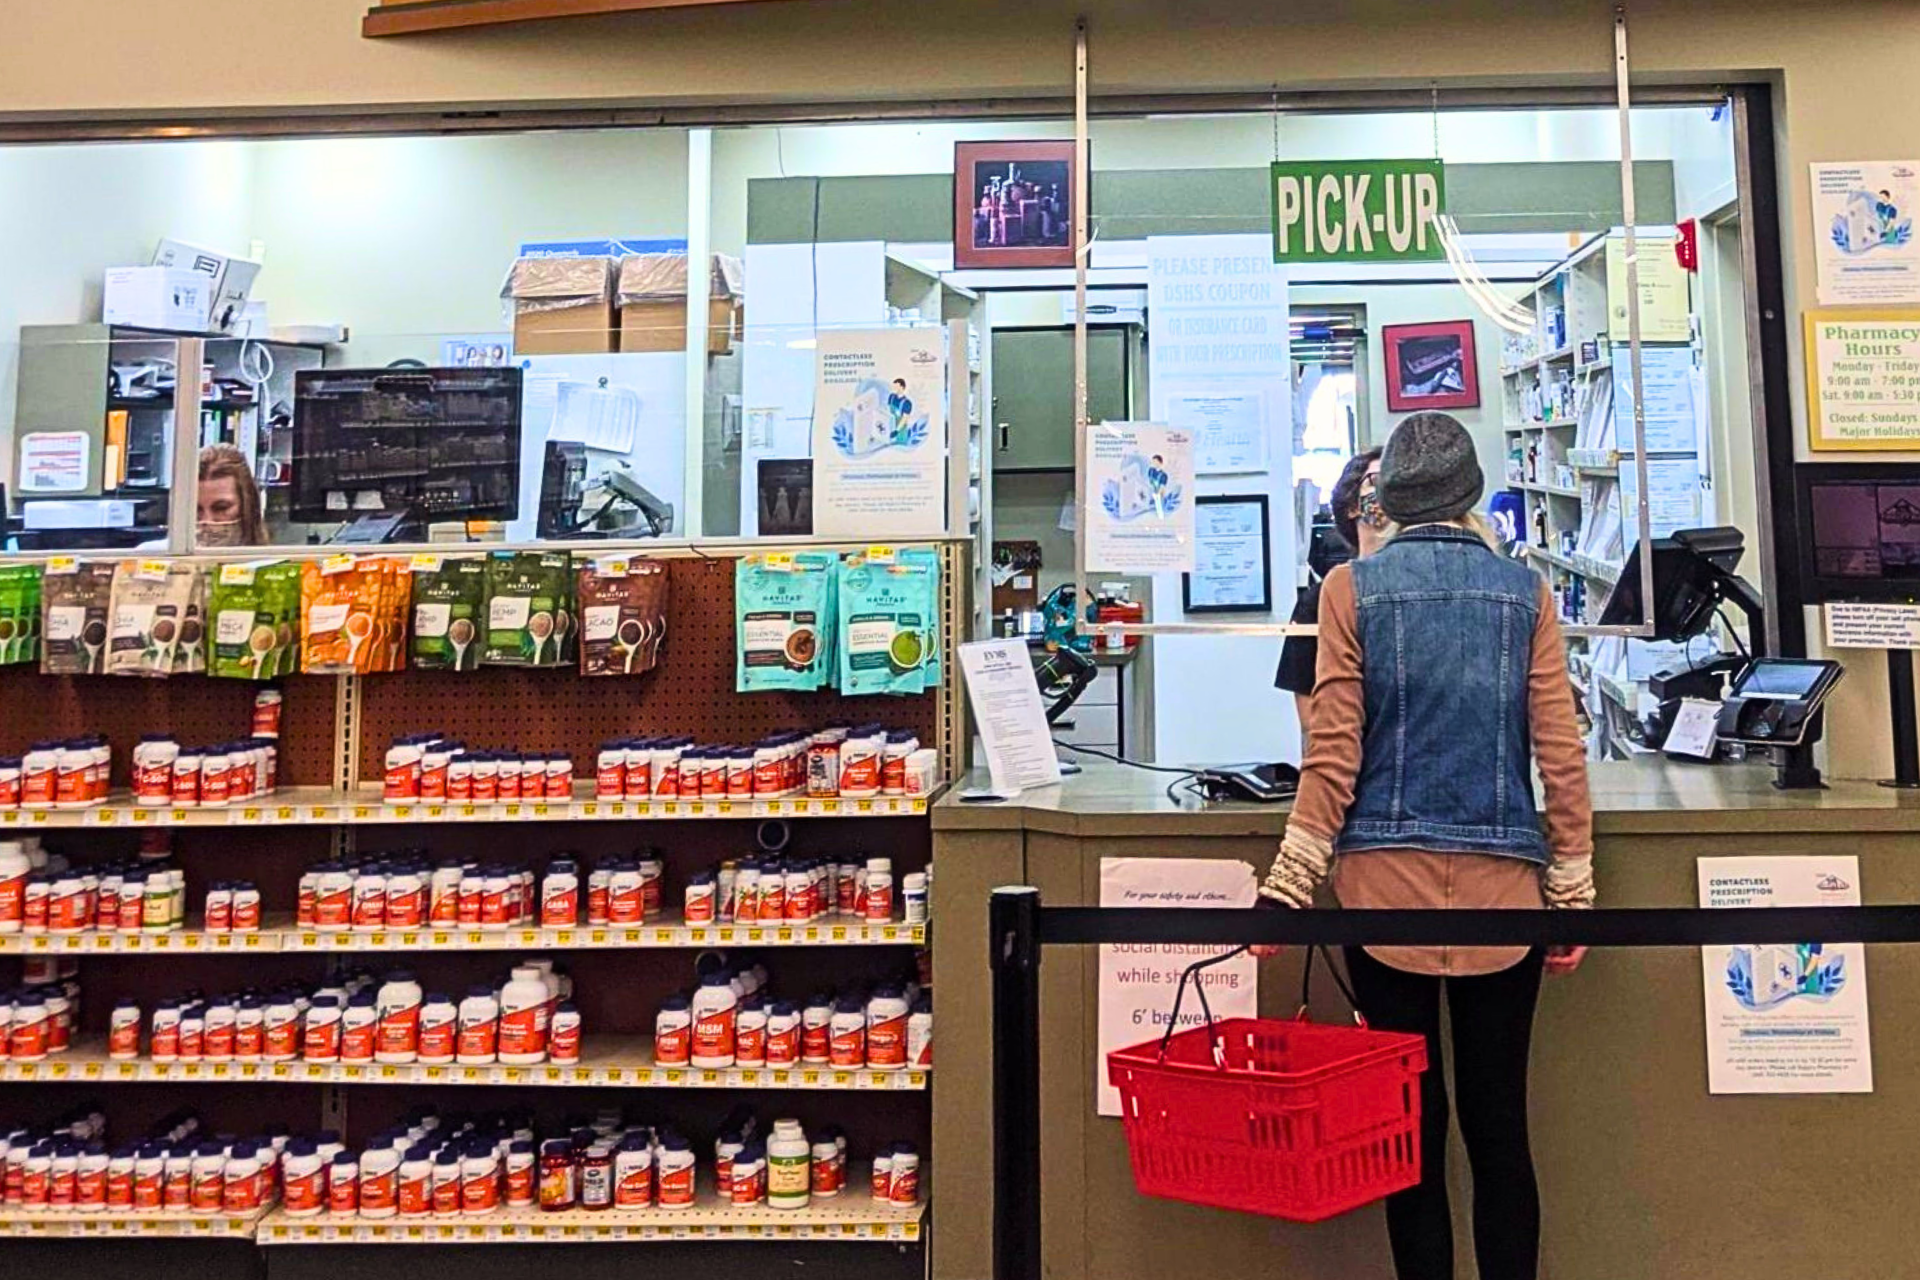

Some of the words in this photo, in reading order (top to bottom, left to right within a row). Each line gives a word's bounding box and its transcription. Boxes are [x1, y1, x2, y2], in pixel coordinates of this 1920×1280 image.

[1277, 173, 1438, 253] PICK-UP
[1153, 257, 1208, 275] PLEASE
[1208, 283, 1271, 301] COUPON
[1825, 325, 1920, 342] Pharmacy
[1845, 343, 1902, 356] Hours
[1832, 362, 1874, 373] Monday
[1885, 361, 1919, 373] Friday
[1827, 376, 1850, 386] 9:00
[1854, 378, 1871, 386] am
[1829, 413, 1868, 423] Closed:
[1871, 412, 1918, 424] Sundays
[1840, 427, 1871, 438] Major
[1710, 878, 1769, 886] CONTACTLESS
[1124, 890, 1137, 899] For
[1139, 892, 1157, 901] your
[1159, 891, 1183, 901] safety
[1185, 891, 1200, 900] and
[1711, 887, 1773, 896] PRESCRIPTION
[1711, 898, 1752, 906] DELIVERY
[1162, 943, 1245, 959] distancin
[1117, 968, 1160, 984] while
[1152, 1009, 1223, 1026] bewen
[697, 1023, 723, 1034] MSM
